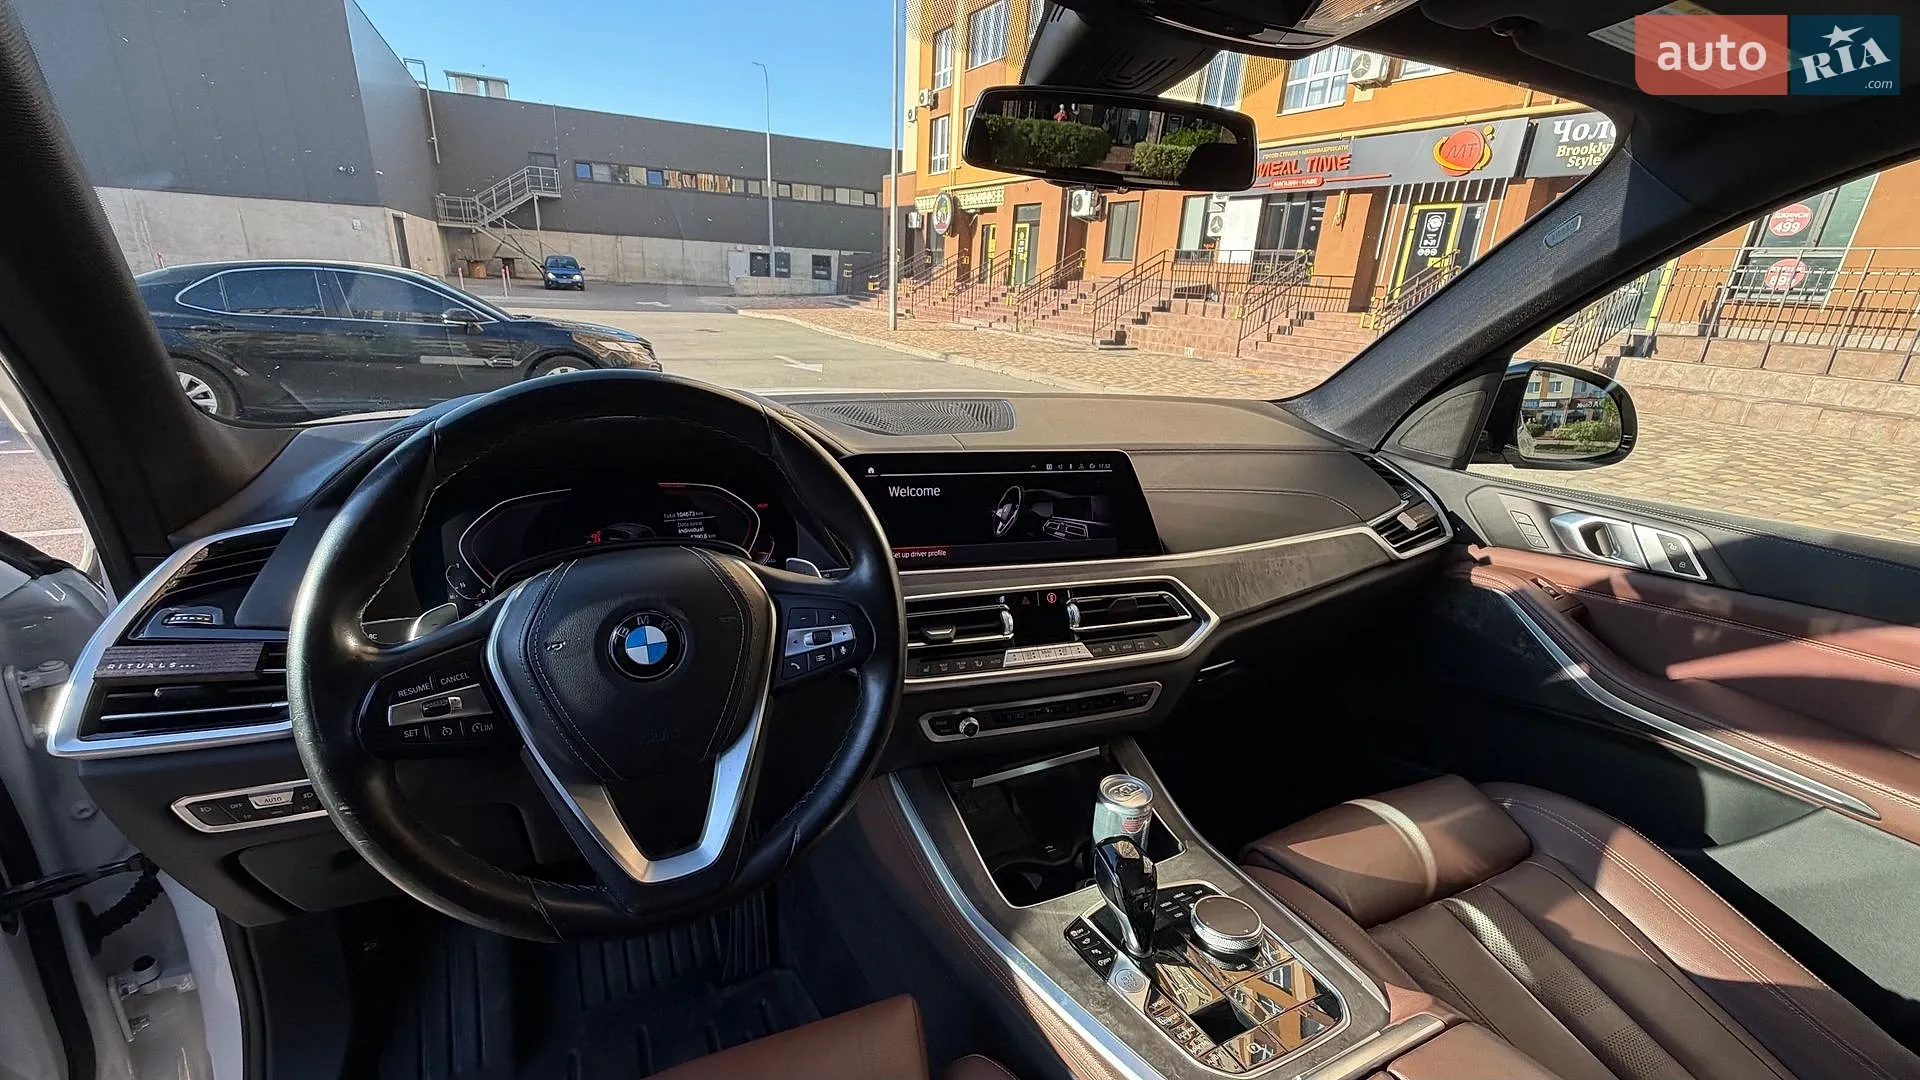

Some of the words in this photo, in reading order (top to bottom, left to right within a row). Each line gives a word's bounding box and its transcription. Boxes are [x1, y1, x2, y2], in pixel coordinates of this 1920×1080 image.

[1304, 152, 1352, 173] TIME
[1774, 221, 1801, 233] 499
[888, 485, 941, 498] Welcome
[910, 549, 927, 558] driver
[927, 549, 947, 559] profile
[616, 615, 674, 638] BMW
[440, 672, 470, 686] CANCEL
[397, 682, 431, 698] RESUME
[403, 728, 419, 738] SET
[264, 796, 282, 804] AUTO
